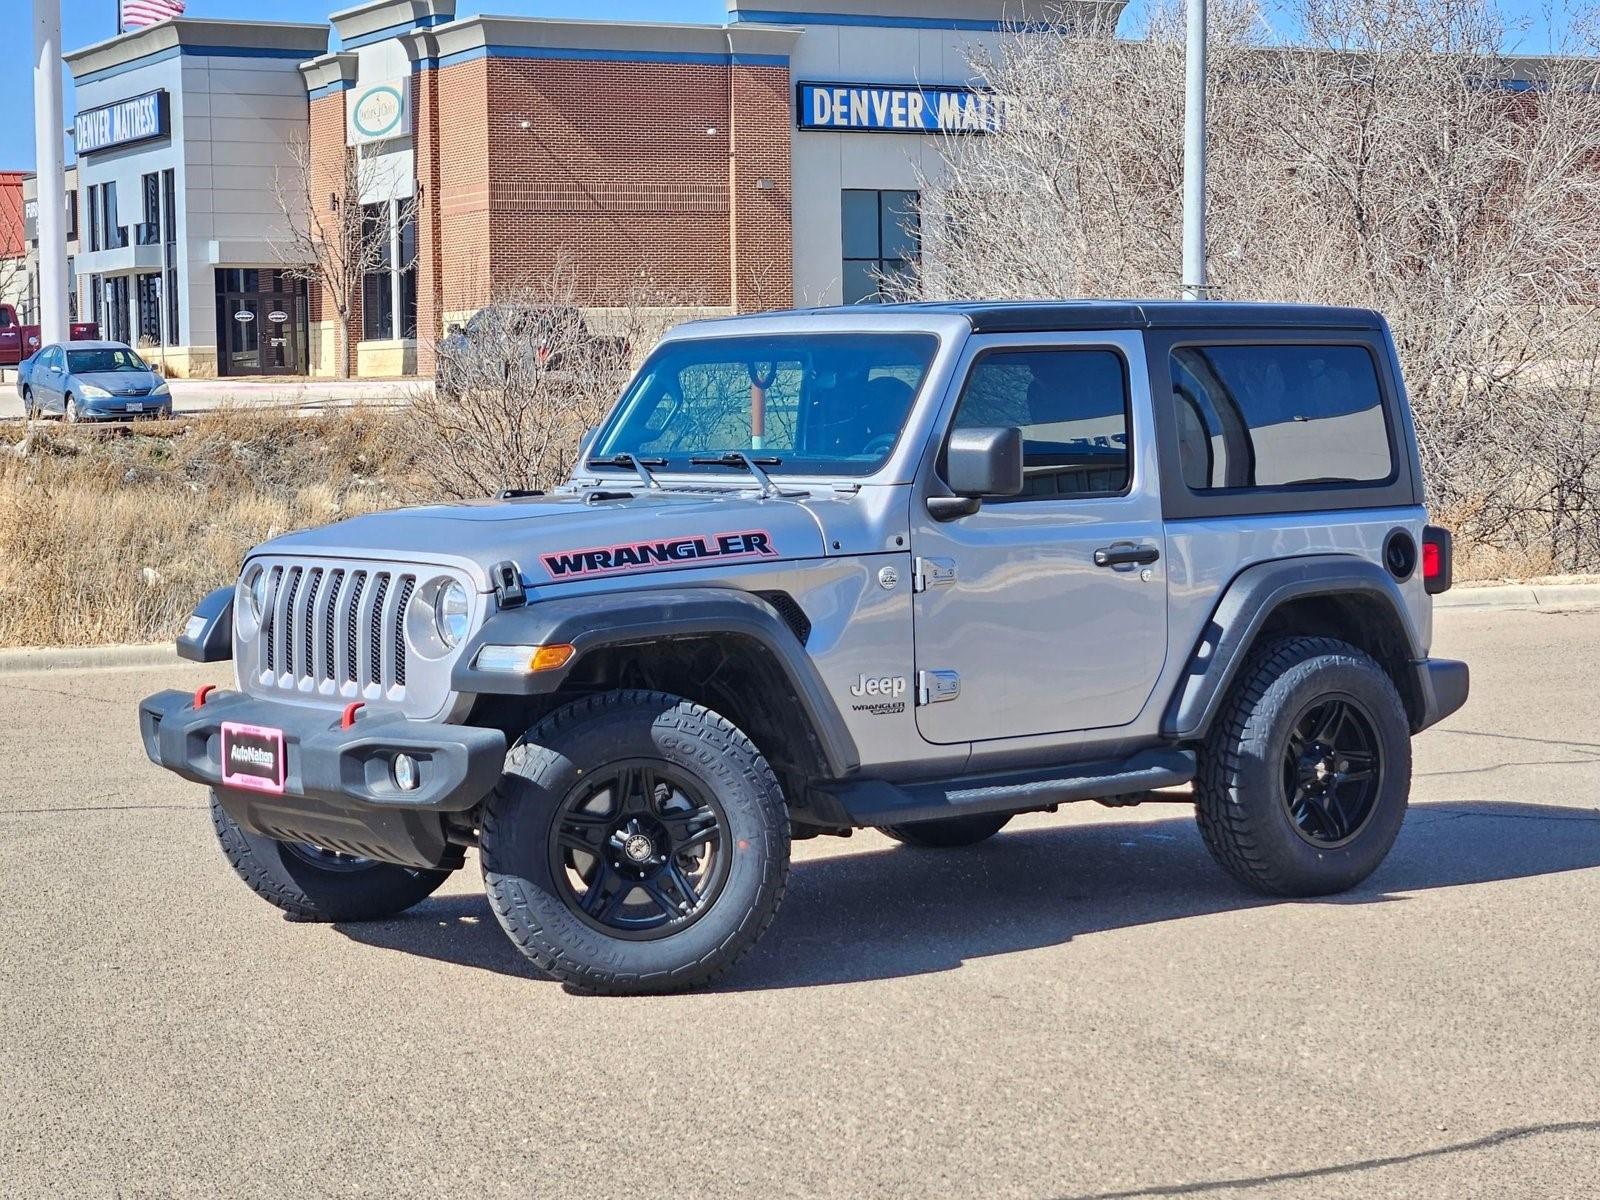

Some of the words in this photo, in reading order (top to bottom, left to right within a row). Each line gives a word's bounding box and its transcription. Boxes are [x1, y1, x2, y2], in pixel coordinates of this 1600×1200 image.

[813, 88, 923, 127] DENVER
[76, 109, 110, 151] DENVER
[113, 96, 155, 140] MATTRESS
[543, 531, 774, 576] WRANGLER
[850, 674, 906, 698] Jeep
[852, 702, 905, 711] WRANGLER
[231, 744, 274, 763] AutoNation
